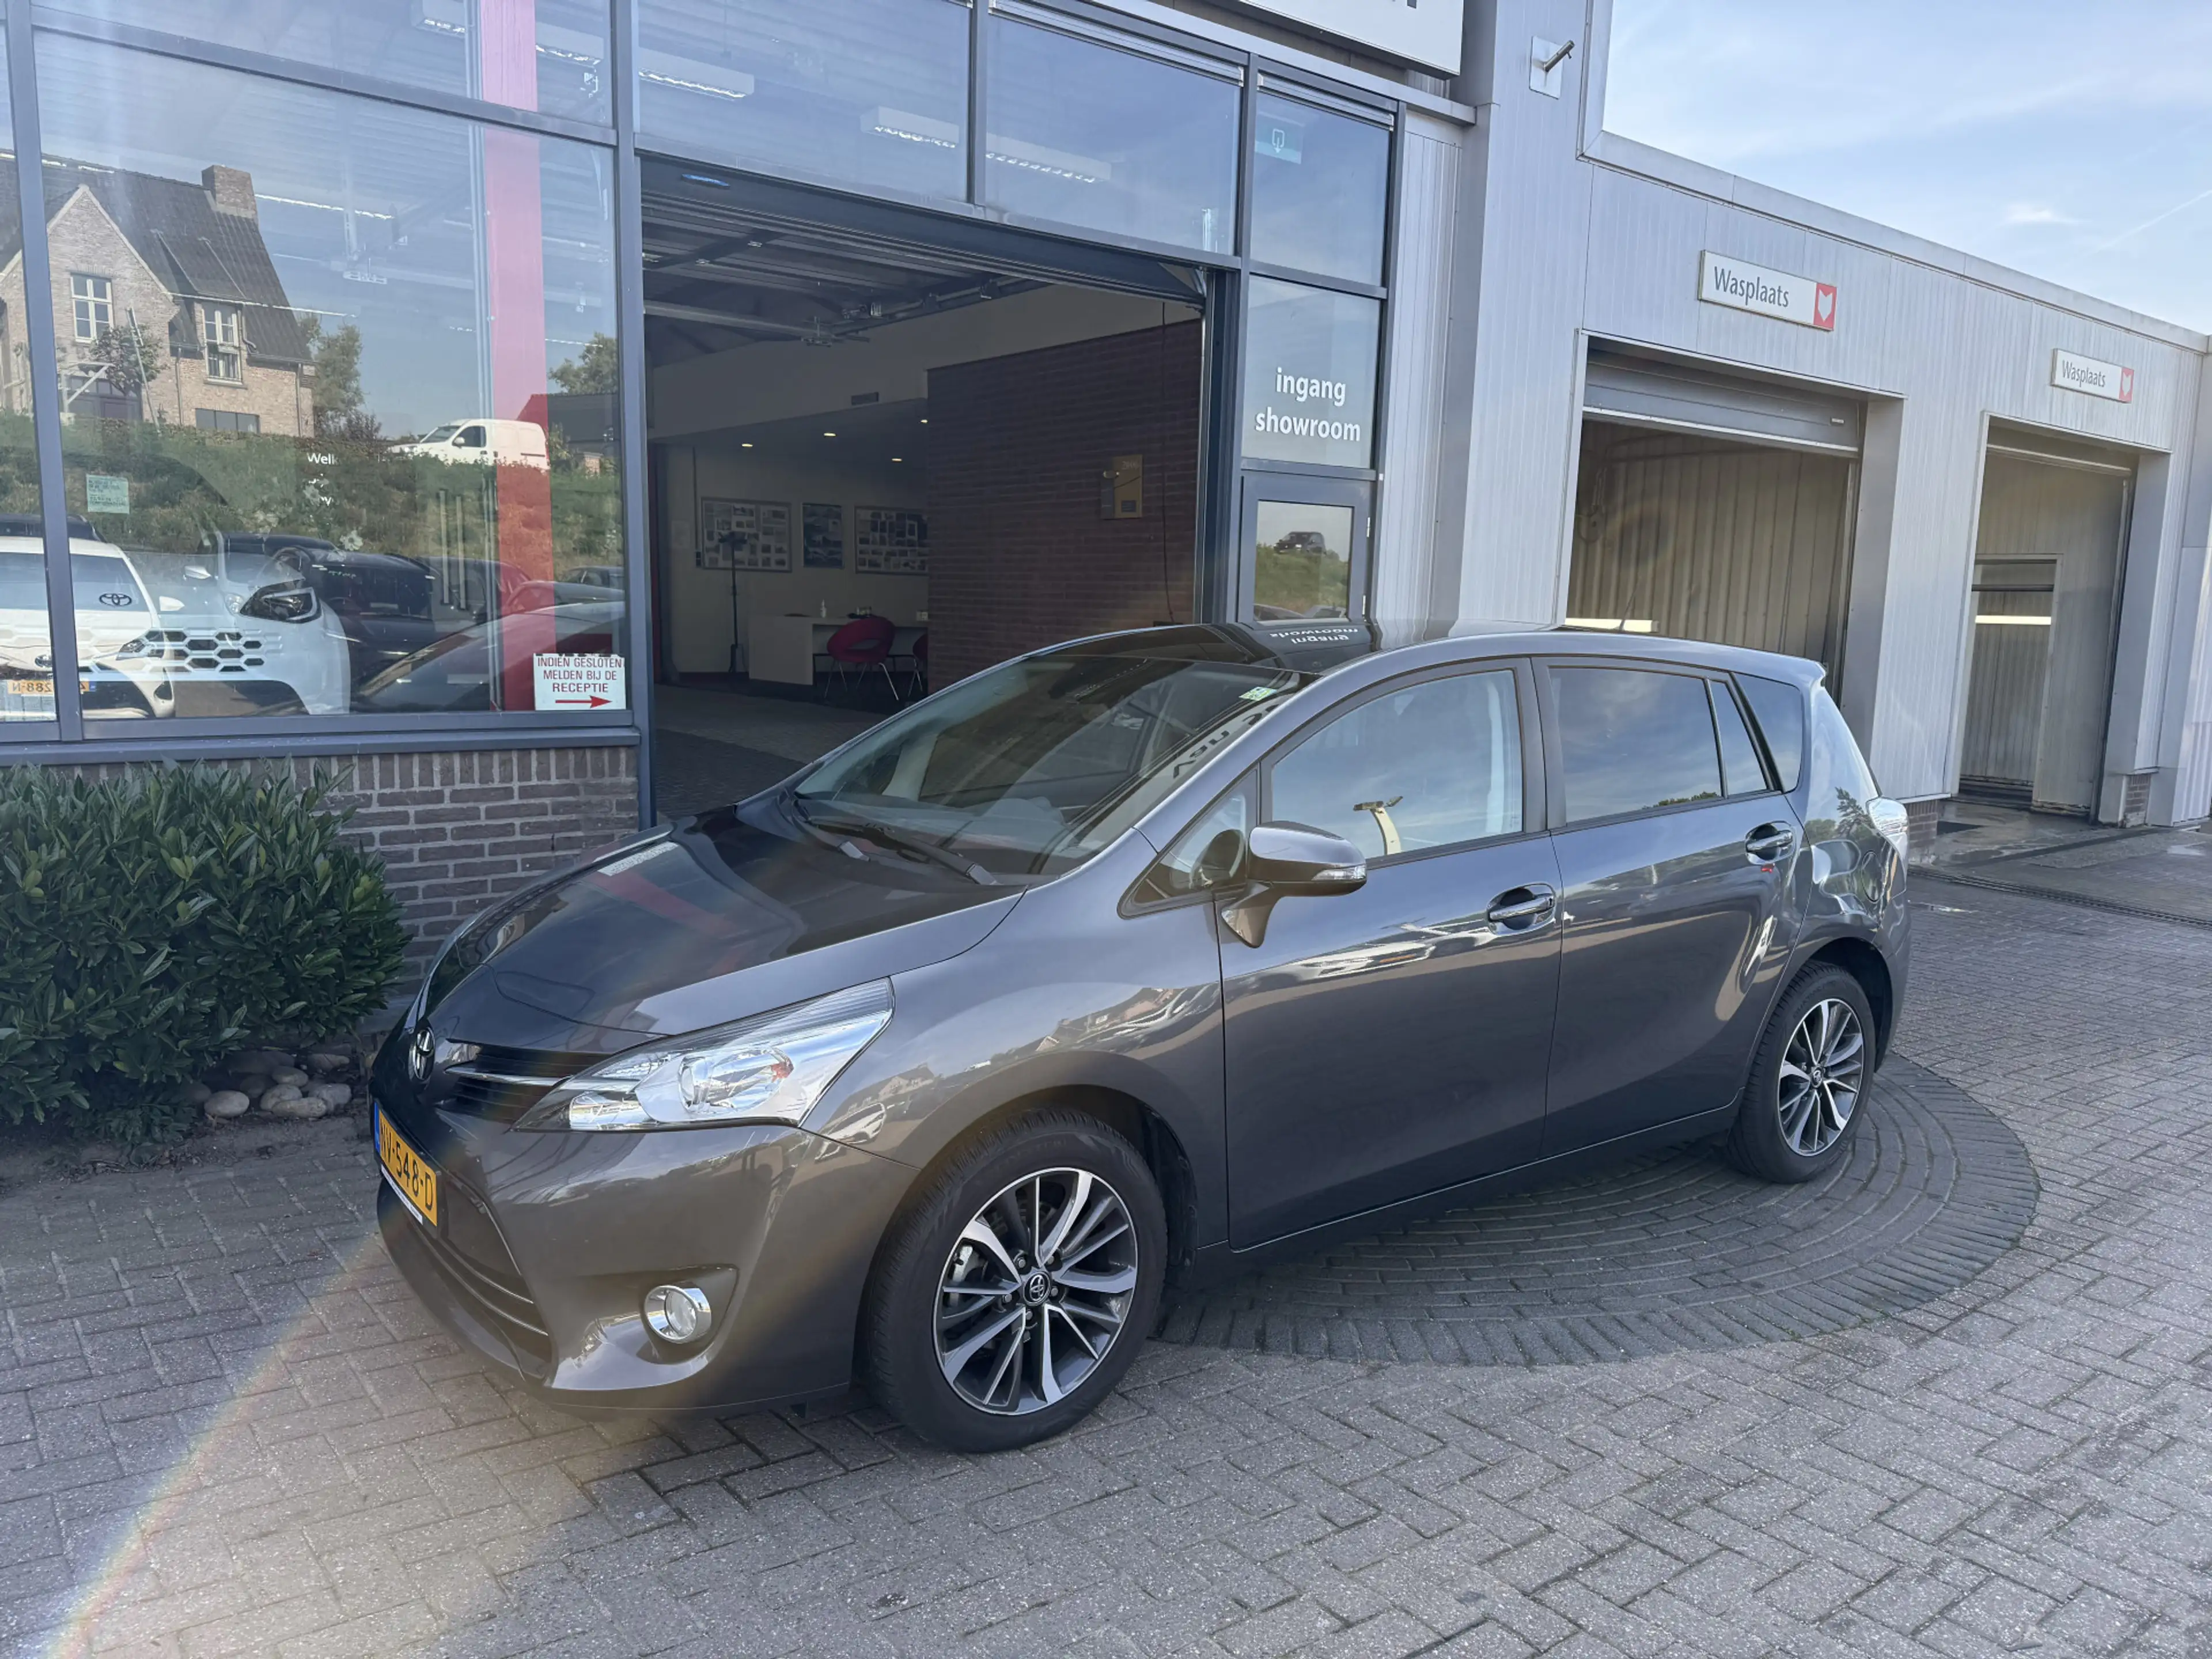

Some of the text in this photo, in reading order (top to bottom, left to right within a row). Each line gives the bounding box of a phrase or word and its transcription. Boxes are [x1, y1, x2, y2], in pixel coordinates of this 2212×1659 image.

[1714, 266, 1789, 308] Wasplaats
[1276, 366, 1347, 407] ingang
[2062, 359, 2106, 388] Wasplaats
[1255, 406, 1361, 441] showroom
[537, 657, 622, 668] INDIEN GESLOTEN
[543, 670, 618, 681] MELDEN BIJ DE
[552, 683, 609, 693] RECEPTIE
